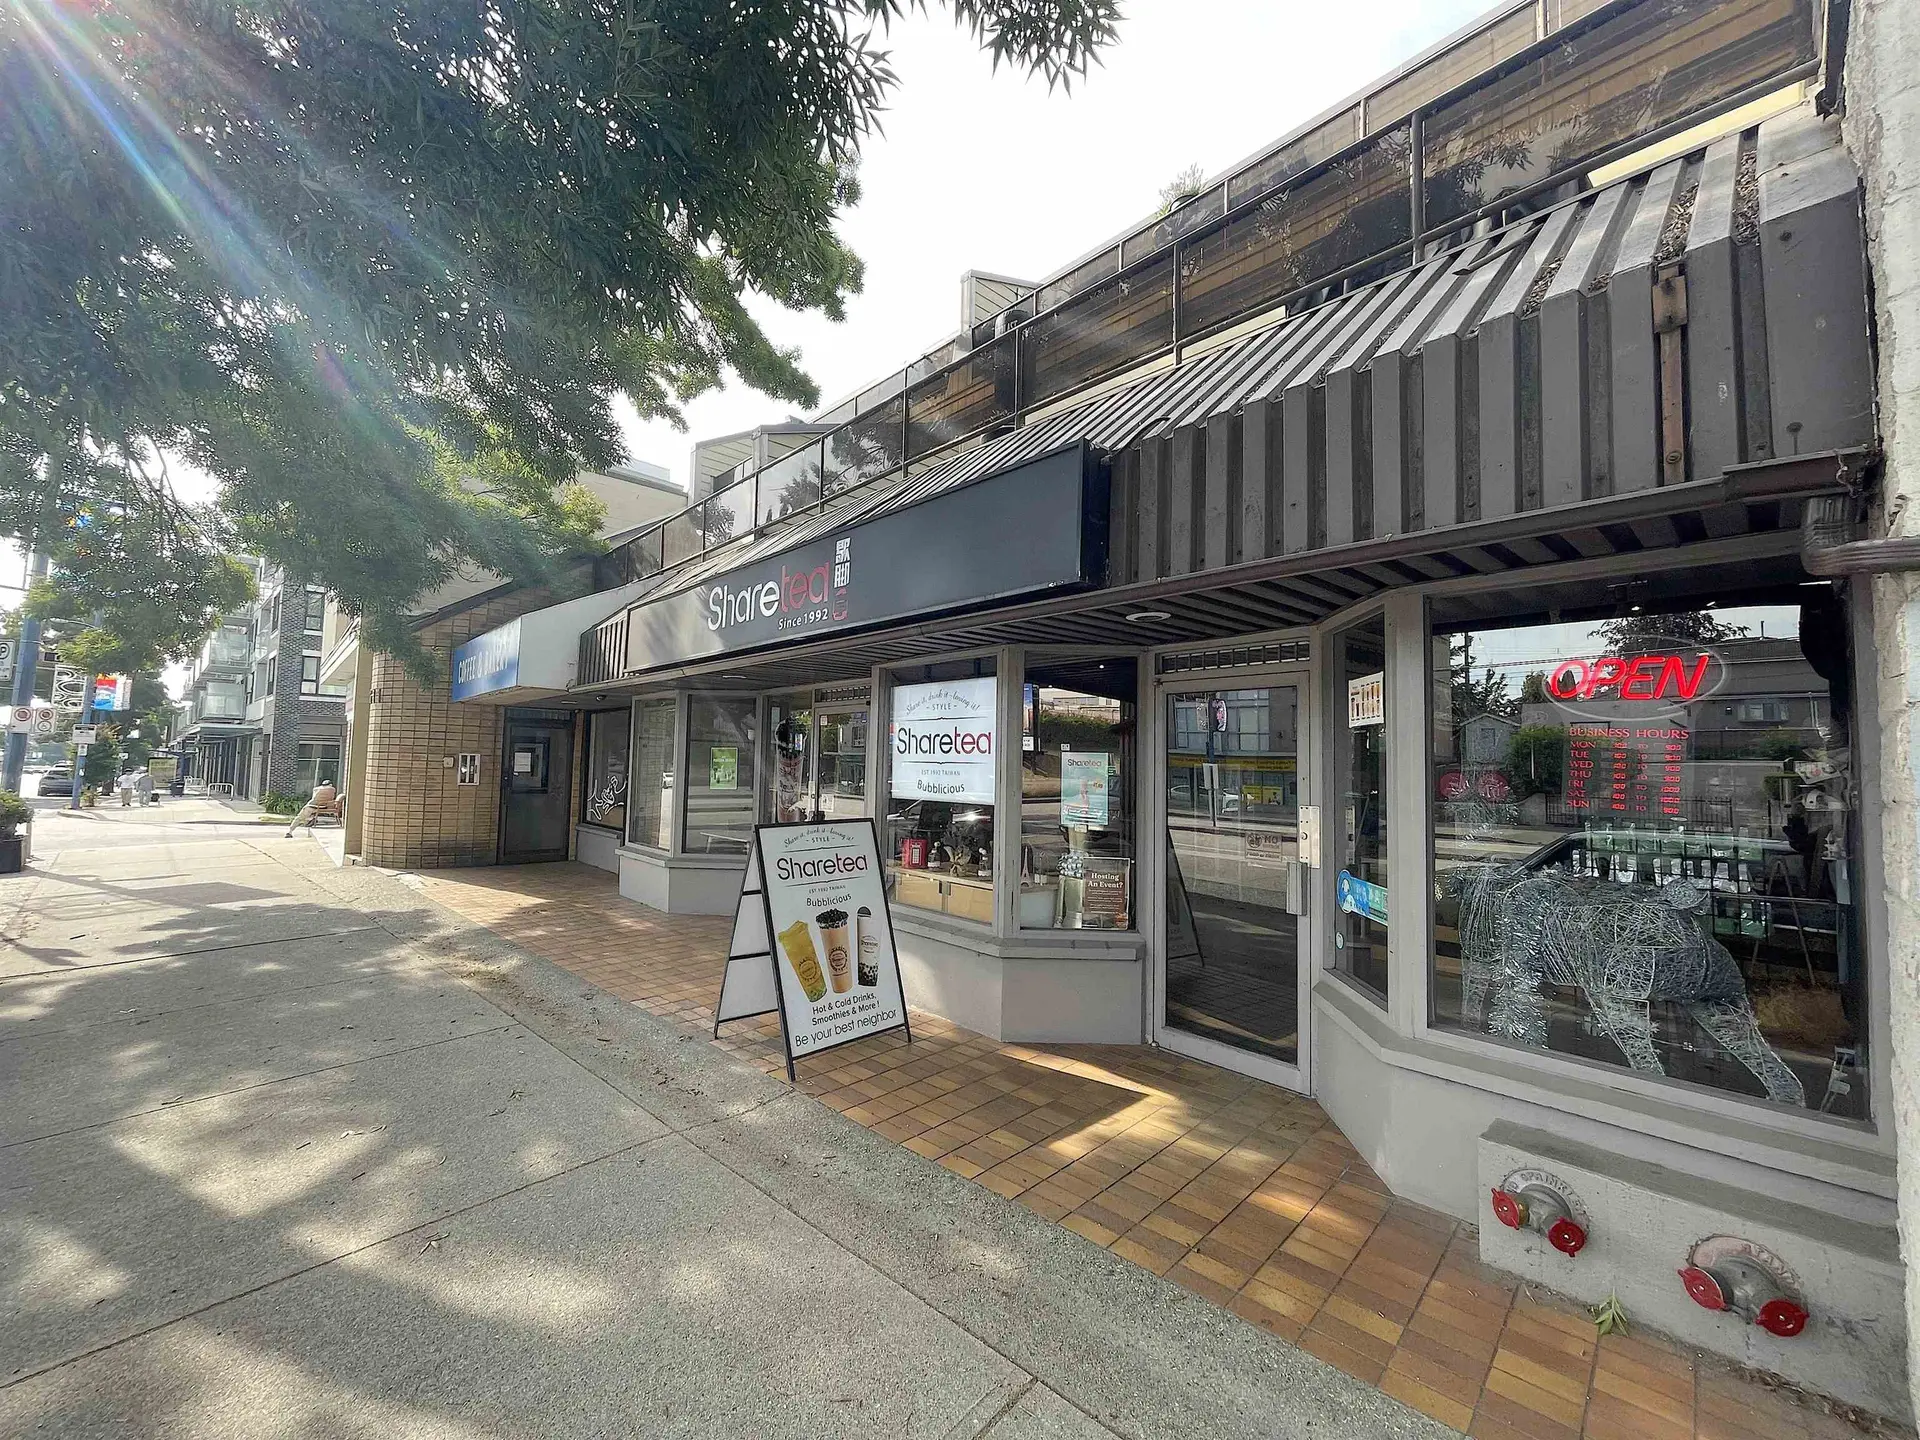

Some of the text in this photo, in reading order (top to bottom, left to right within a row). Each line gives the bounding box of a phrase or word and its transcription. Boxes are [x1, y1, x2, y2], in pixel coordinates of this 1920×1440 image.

[707, 561, 830, 631] Sharetea
[778, 608, 828, 630] Since 1992
[1550, 653, 1710, 700] OPEN
[932, 702, 952, 711] STYLE
[1569, 727, 1689, 739] BUSINESS HOURS
[897, 726, 991, 755] Sharetea
[1570, 741, 1596, 749] MON
[1570, 750, 1589, 758] TUE
[1569, 760, 1593, 769] WED
[1570, 770, 1592, 778] THU
[917, 779, 965, 795] Bubblicious
[1567, 800, 1589, 808] SUN
[811, 836, 830, 844] STYLE
[776, 853, 868, 880] Sharetea
[1091, 872, 1120, 882] Hosting
[1100, 881, 1123, 889] Event?
[806, 893, 852, 907] Bubblicious
[812, 1005, 827, 1015] Hot
[827, 1002, 834, 1011] &
[834, 998, 851, 1009] Cold
[812, 1009, 851, 1026] Smoothies
[858, 1002, 876, 1013] More
[795, 1009, 897, 1047] Be your best neighbor
